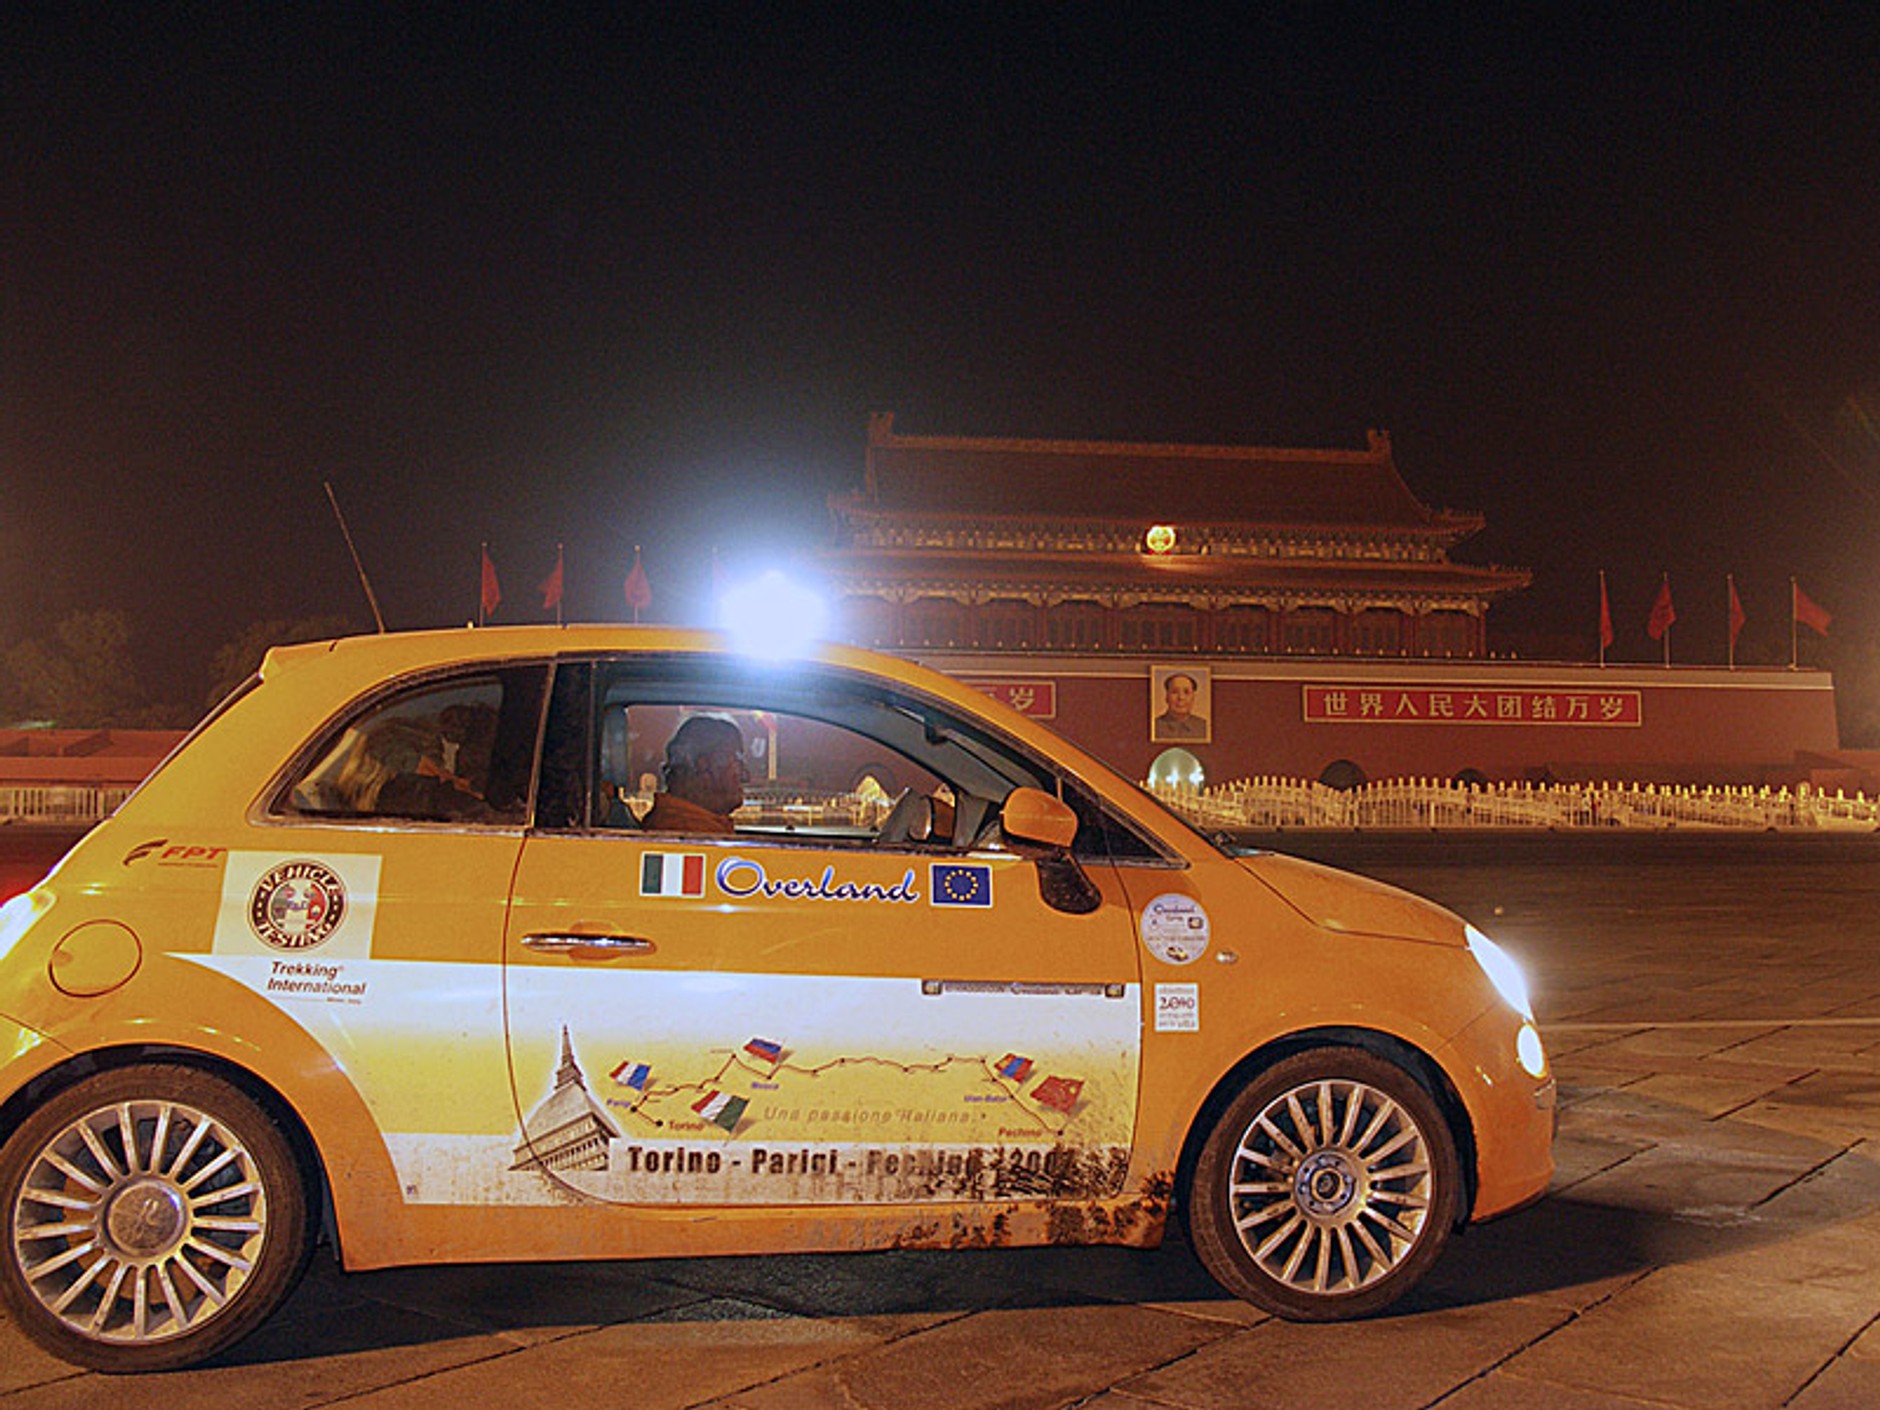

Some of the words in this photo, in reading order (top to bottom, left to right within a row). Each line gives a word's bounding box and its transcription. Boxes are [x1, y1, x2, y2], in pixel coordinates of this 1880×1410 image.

[1323, 691, 1625, 720] 世界人民大团结万岁
[161, 846, 227, 859] FPT
[260, 864, 341, 893] VEHICLE
[715, 856, 919, 902] Overland
[257, 920, 332, 947] TESTING
[271, 961, 338, 980] Trekking
[267, 977, 366, 995] International
[628, 1146, 721, 1174] Torino
